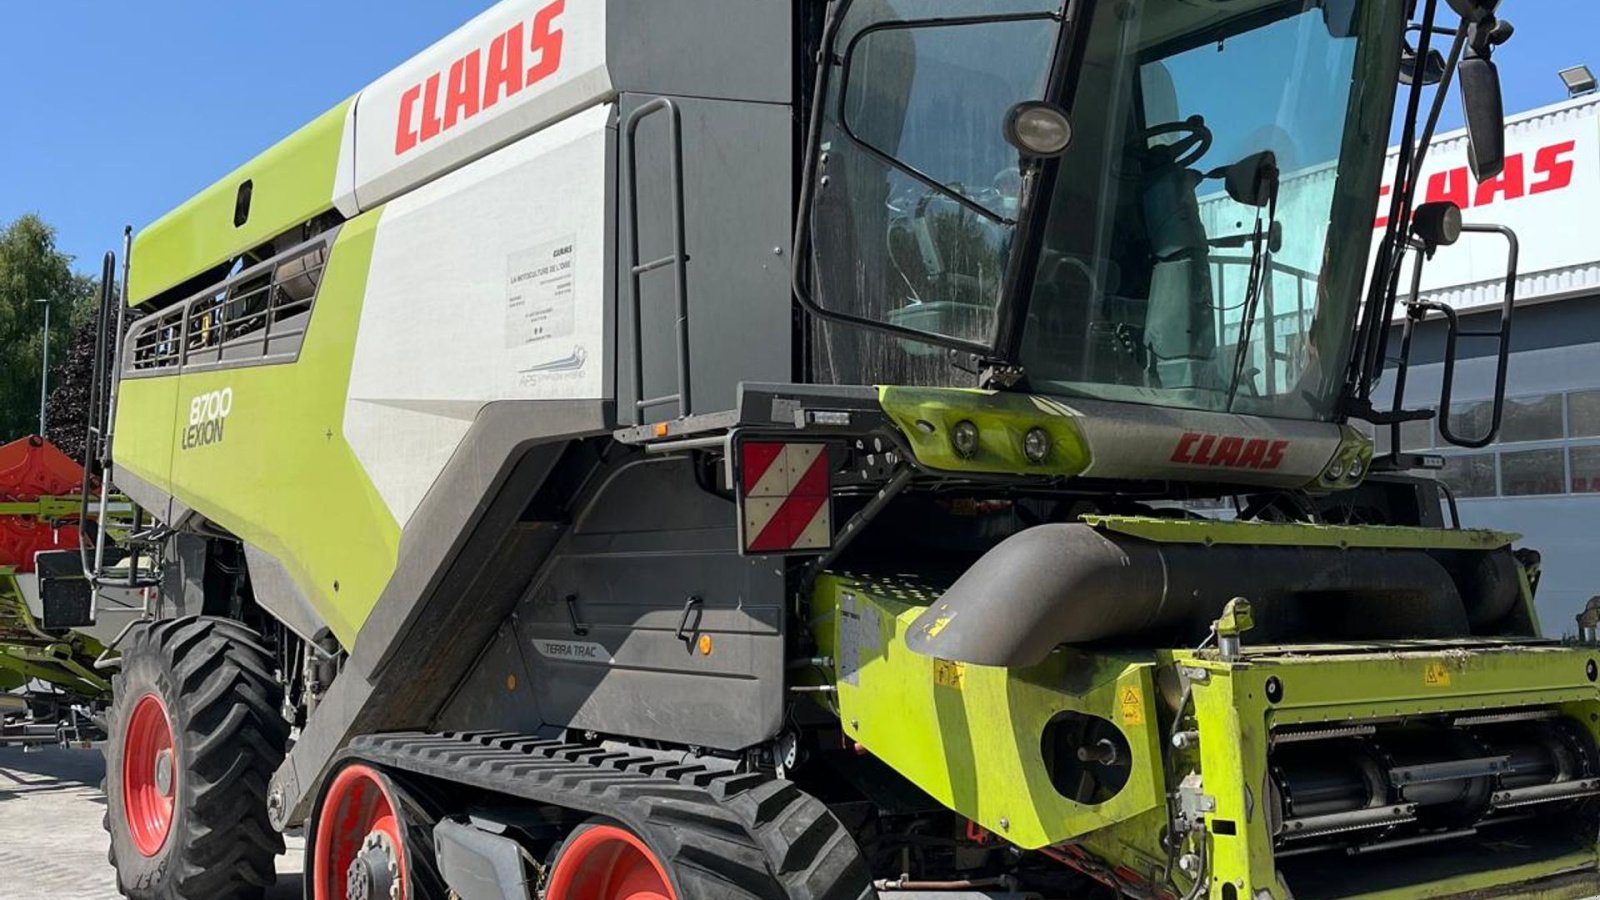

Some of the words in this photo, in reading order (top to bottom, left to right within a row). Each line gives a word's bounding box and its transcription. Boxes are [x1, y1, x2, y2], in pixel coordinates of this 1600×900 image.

[395, 0, 565, 155] CLAAS
[1372, 140, 1575, 228] AAS
[190, 387, 232, 426] 8700
[182, 416, 224, 450] LEXION
[1170, 432, 1289, 469] CLAAS
[545, 643, 572, 656] TERRA
[573, 646, 597, 658] TRAC
